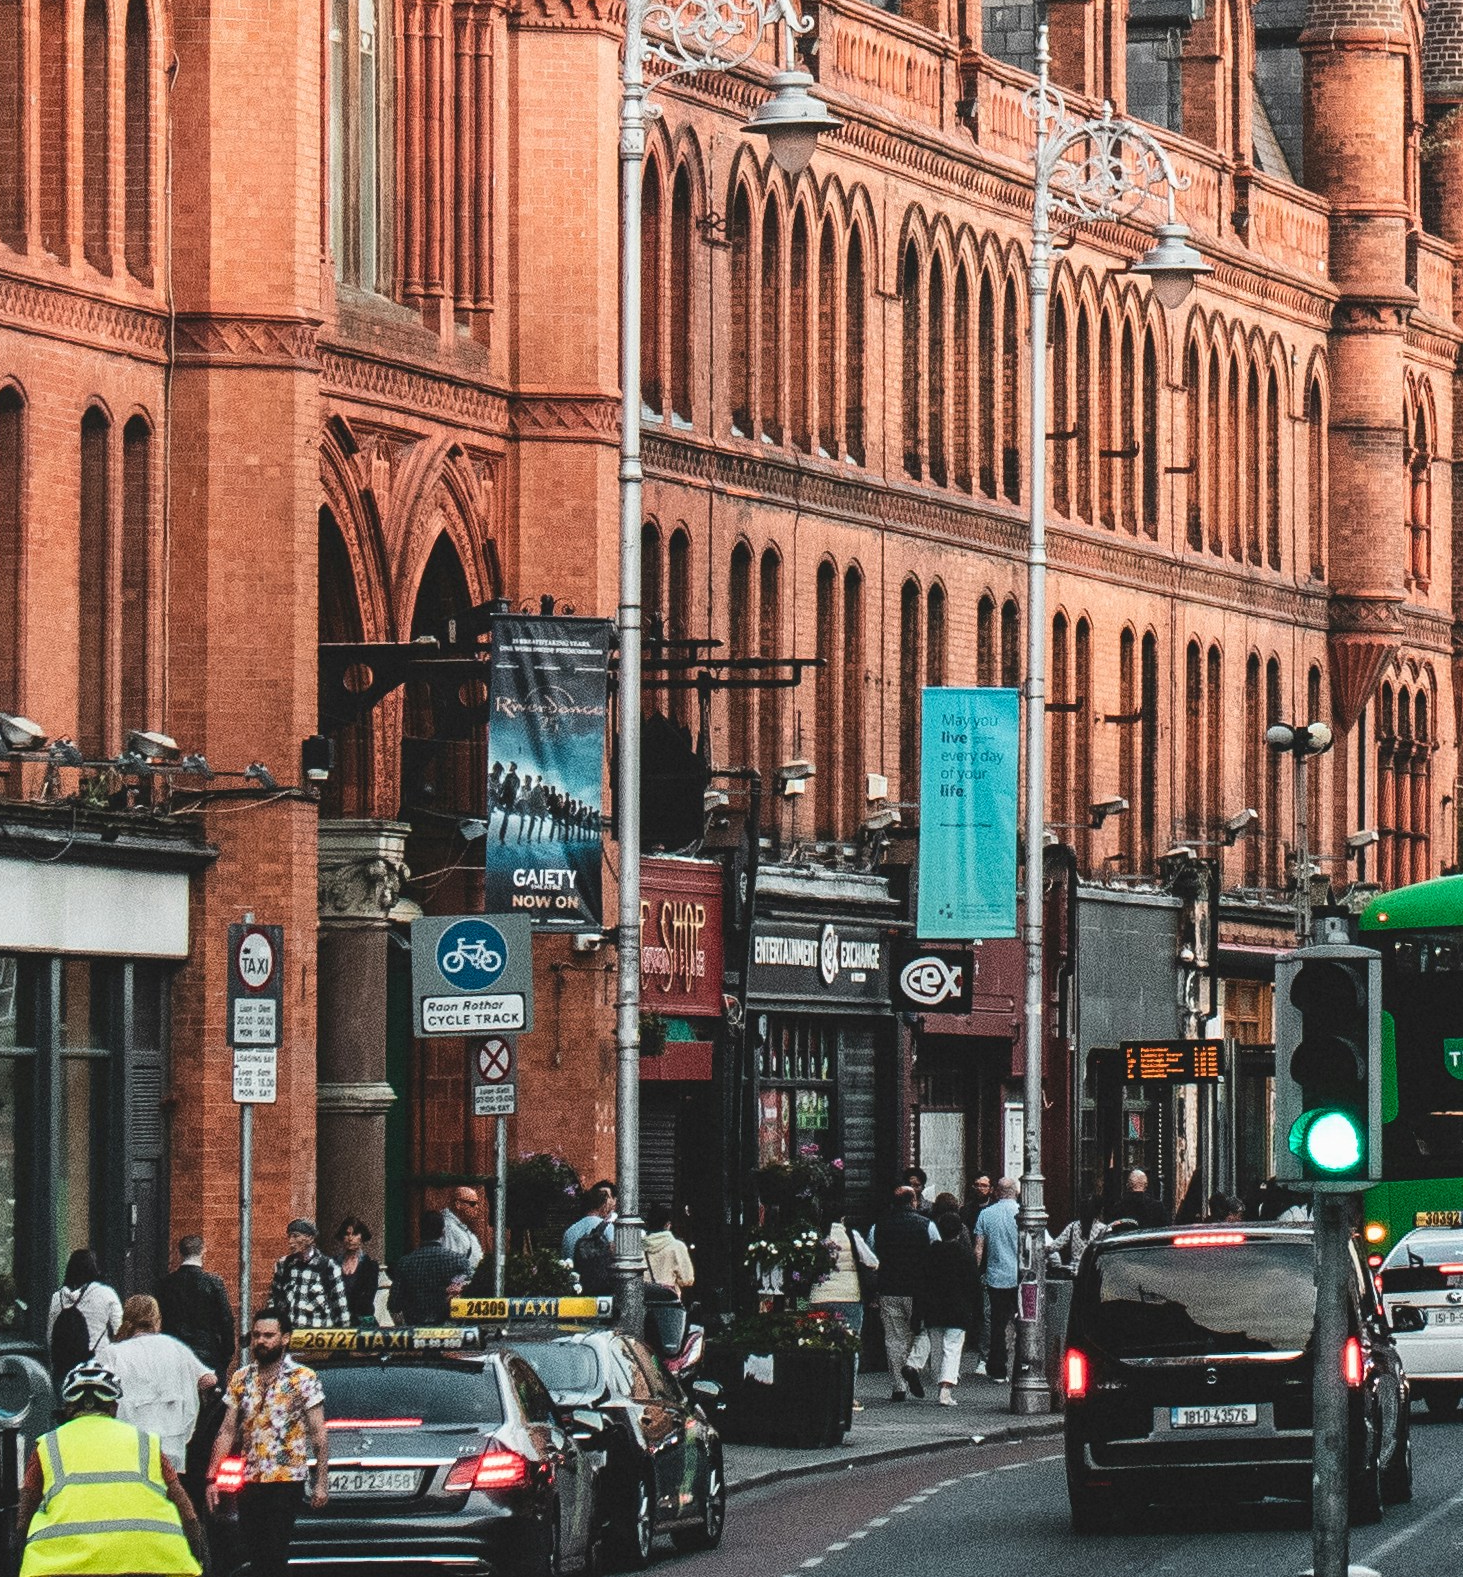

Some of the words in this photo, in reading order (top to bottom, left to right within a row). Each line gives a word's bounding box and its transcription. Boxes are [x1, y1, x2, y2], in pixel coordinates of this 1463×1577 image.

[941, 714, 969, 730] May
[973, 716, 999, 730] you
[941, 731, 967, 744] live
[941, 751, 978, 765] every
[979, 750, 1004, 765] day
[940, 767, 955, 779] of
[956, 769, 988, 783] your
[940, 784, 967, 797] life.
[513, 868, 577, 889] GAIETY
[512, 894, 551, 908] NOW
[556, 895, 579, 909] ON
[660, 900, 707, 993] SHOP
[754, 935, 818, 965] ENTERTAINMENT
[840, 940, 880, 970] EXCHANGE
[242, 957, 269, 975] TAXI
[427, 1002, 458, 1012] Raon
[462, 1000, 504, 1011] Rothar
[428, 1015, 470, 1026] CYCLE
[474, 1013, 519, 1024] TRACK
[1425, 1210, 1462, 1225] 30392
[466, 1300, 507, 1316] 24309
[513, 1300, 557, 1317] TAXI
[304, 1331, 358, 1349] 26727
[361, 1330, 409, 1349] TAXI
